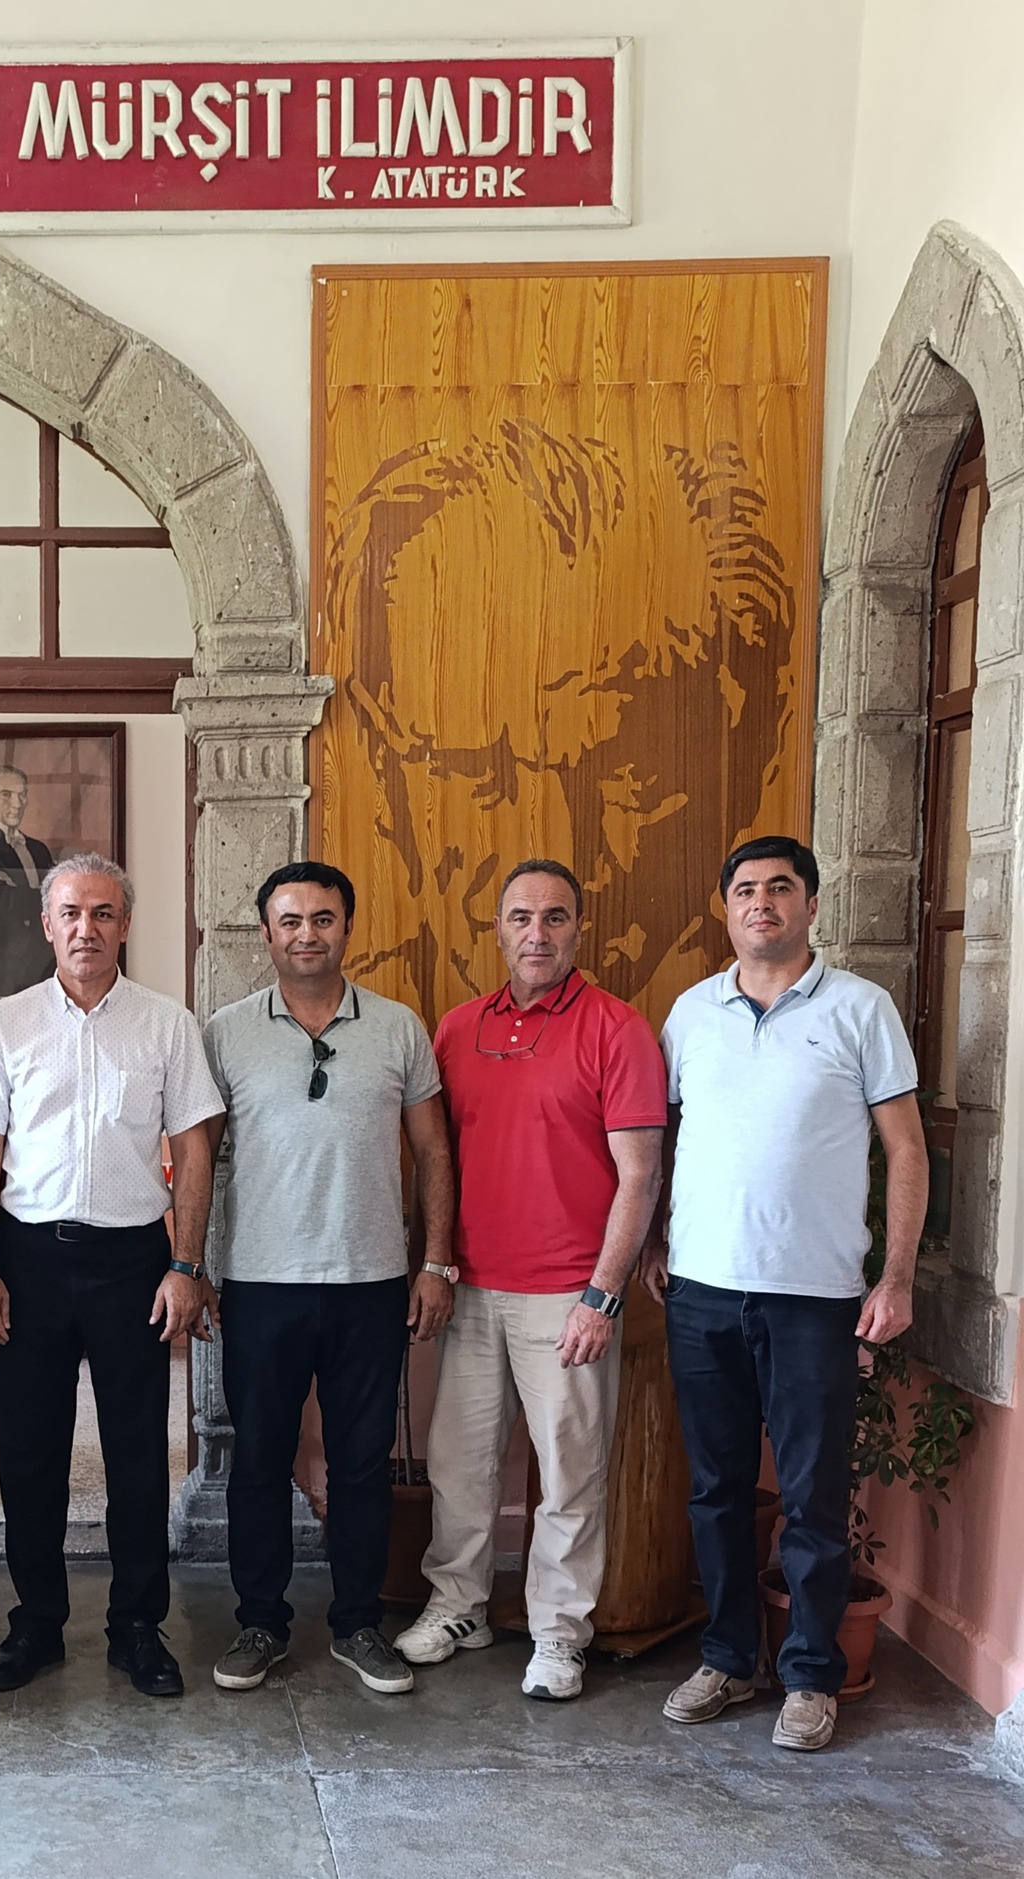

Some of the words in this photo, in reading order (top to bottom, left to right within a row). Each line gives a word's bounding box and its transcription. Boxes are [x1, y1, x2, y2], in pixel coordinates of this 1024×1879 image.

[18, 78, 292, 184] MÜRŞİT
[316, 76, 593, 159] İLİMDİR
[316, 165, 355, 200] K.
[371, 164, 527, 200] ATATÜRK
